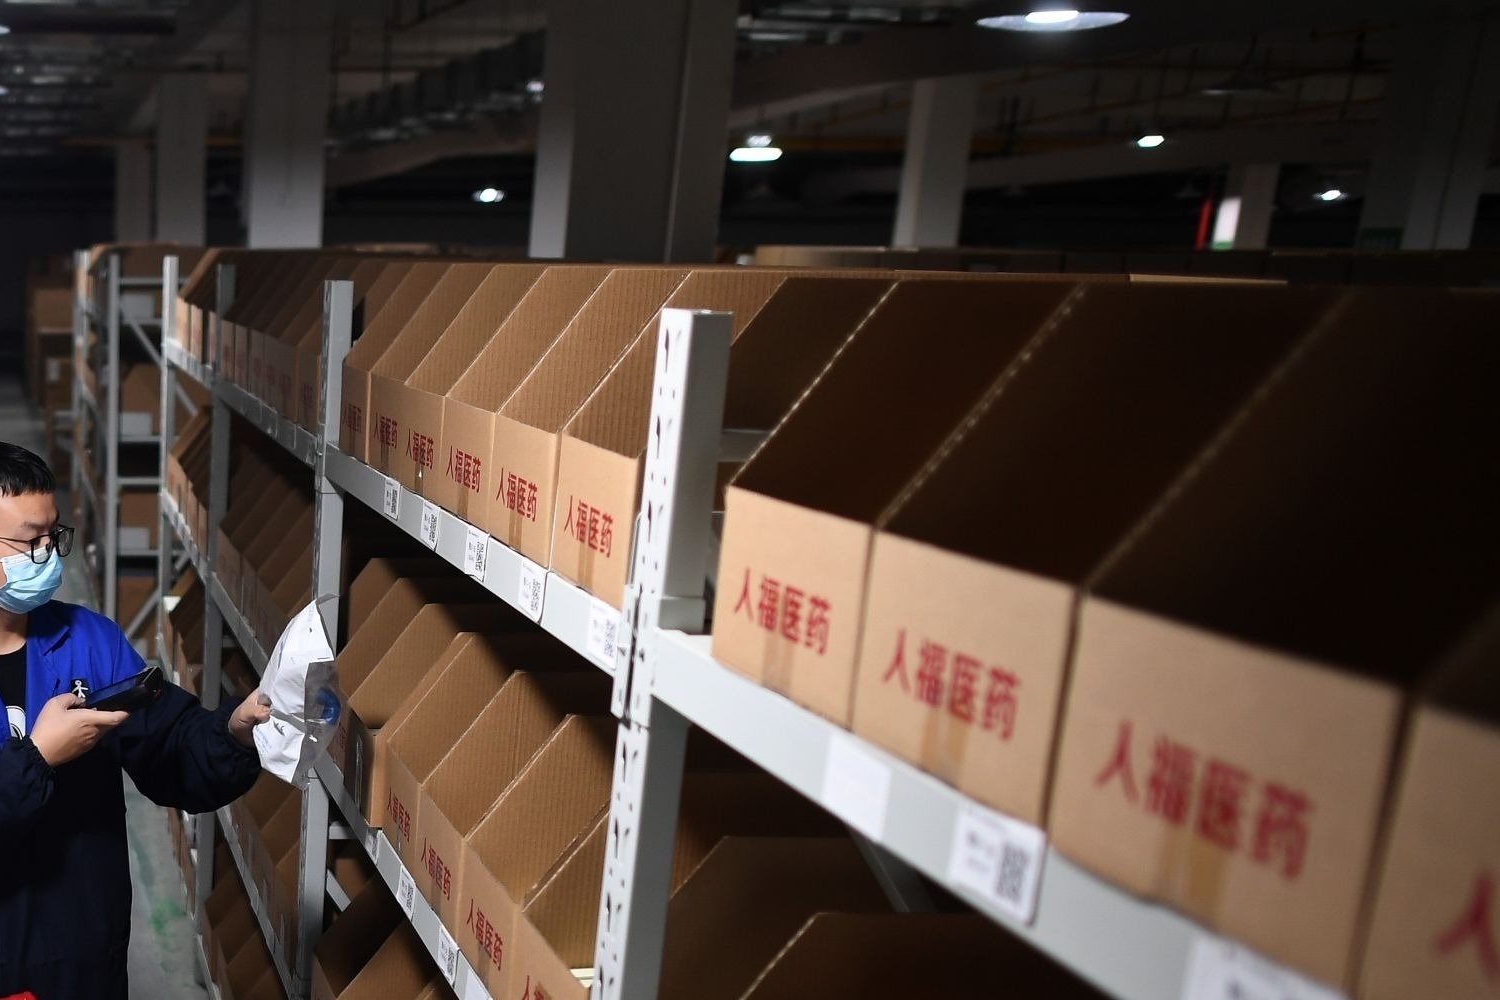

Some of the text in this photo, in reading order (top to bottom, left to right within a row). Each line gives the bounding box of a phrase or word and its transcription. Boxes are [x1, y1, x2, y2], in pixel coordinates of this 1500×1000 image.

[373, 411, 398, 449] 人福医药
[405, 428, 434, 470] 人福医药
[446, 446, 481, 493] 人福医药
[496, 467, 538, 522] 人福医药
[564, 495, 613, 559] 人福医药
[733, 566, 832, 656] 人福医药
[881, 628, 1023, 742] 人福医药
[387, 786, 411, 843] 人福医药
[1094, 718, 1314, 882] 人福医药
[420, 837, 452, 902] 人福医药
[466, 898, 504, 972] 人福医药
